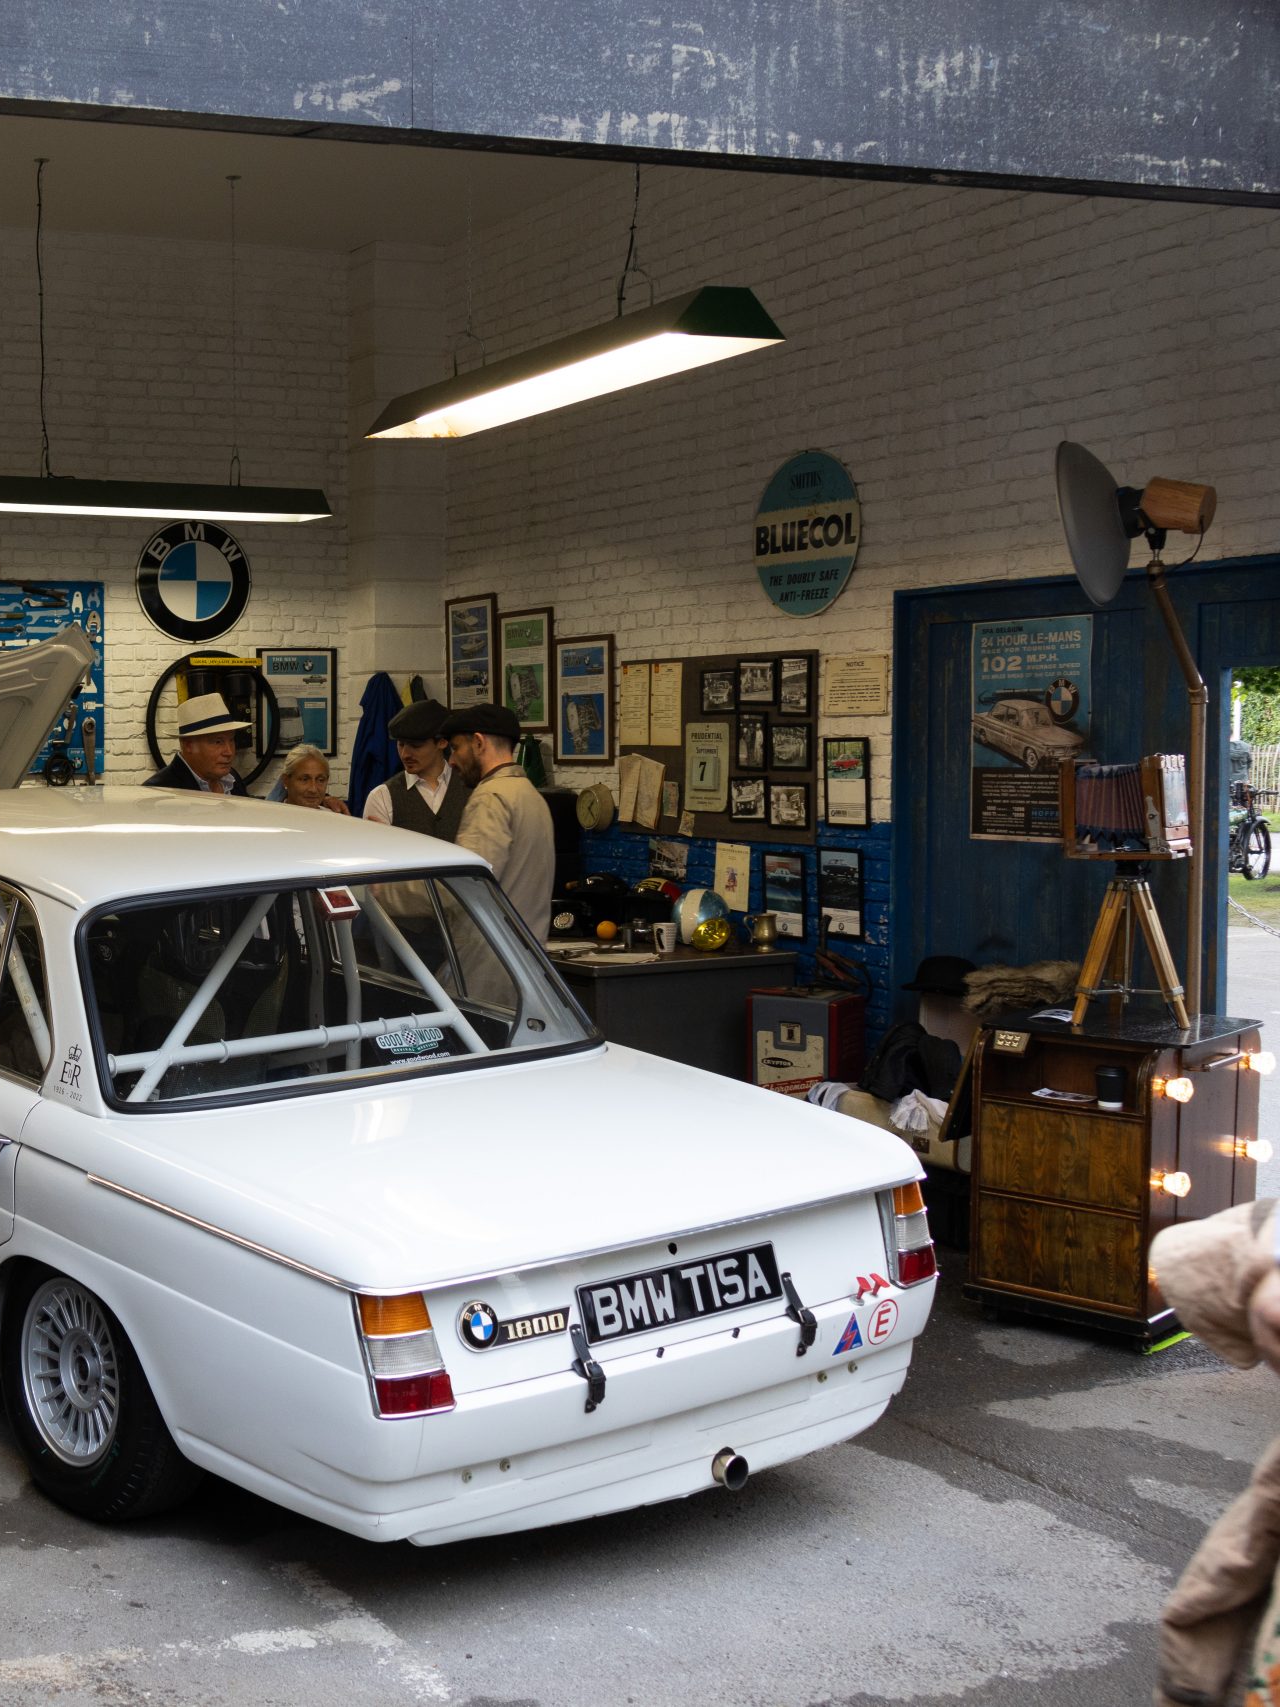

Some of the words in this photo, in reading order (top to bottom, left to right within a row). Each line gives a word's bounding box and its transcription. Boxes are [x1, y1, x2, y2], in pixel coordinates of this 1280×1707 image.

[790, 471, 822, 490] SMITHS
[147, 522, 243, 563] BMW
[755, 512, 857, 556] BLUECOL
[769, 575, 783, 587] THE
[787, 571, 816, 585] DOUBLY
[819, 568, 840, 582] SAFE
[779, 587, 830, 603] ANTI-FREEZE
[981, 637, 994, 648] 24
[996, 634, 1029, 647] HOUR
[1030, 630, 1082, 645] LE-MANS
[272, 662, 300, 671] BMW
[981, 655, 1023, 673] 102
[475, 686, 489, 696] BMW
[691, 732, 723, 740] PRUDENTIAL
[698, 761, 707, 782] 7
[390, 1052, 450, 1064] www.goodwood.com
[591, 1273, 676, 1337] BMW
[679, 1252, 772, 1313] TISA
[463, 1303, 494, 1321] BMW
[501, 1312, 565, 1340] 1800
[874, 1308, 891, 1338] E
